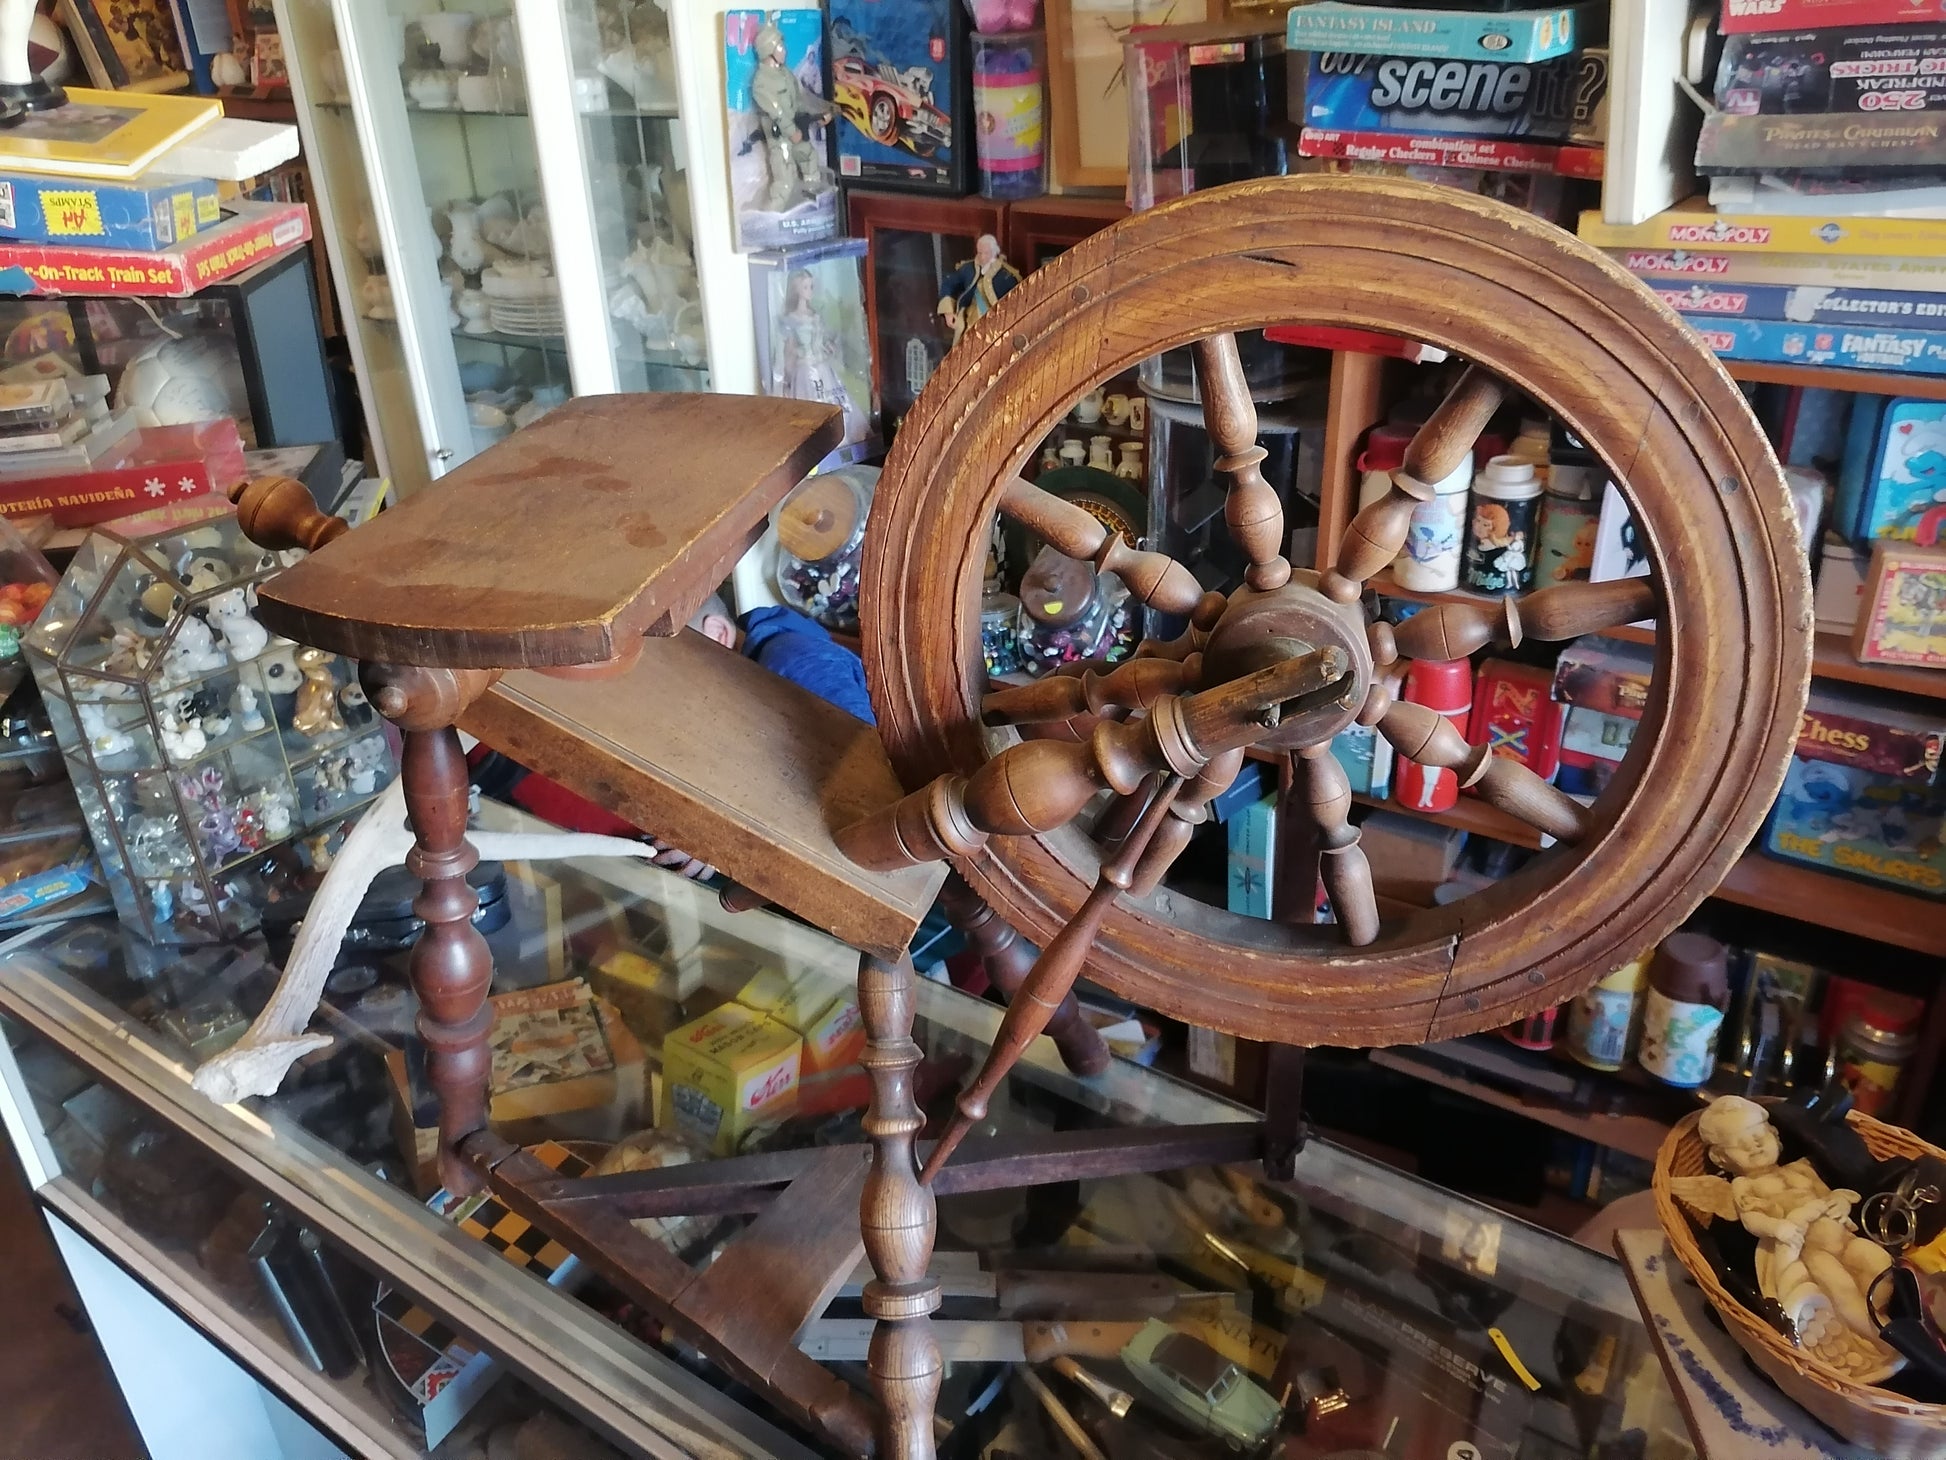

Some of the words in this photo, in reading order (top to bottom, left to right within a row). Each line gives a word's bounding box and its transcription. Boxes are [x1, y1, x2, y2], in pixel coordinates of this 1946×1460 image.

[1729, 0, 1786, 17] WARS
[1296, 15, 1366, 31] FANTASY
[1372, 18, 1437, 33] ISLAND
[1830, 59, 1918, 78] TRICKS
[1371, 58, 1534, 113] scene
[1856, 76, 1946, 90] NDFREAK
[1858, 90, 1926, 111] 250
[1346, 144, 1388, 160] Regular
[1388, 146, 1436, 161] Checkers
[1409, 137, 1477, 153] combination
[1478, 142, 1496, 155] set
[1457, 151, 1500, 166] Chinese
[1670, 226, 1770, 243] MONOPOLY
[1628, 254, 1729, 273] MONOPOLY
[107, 266, 146, 283] Train
[149, 268, 174, 285] Set
[1815, 297, 1914, 315] COLLECTOR'S
[1841, 333, 1928, 358] FANTASY
[0, 495, 54, 515] OTERÍA
[57, 486, 136, 508] NAVIDEÑA
[1799, 713, 1871, 751] Chess
[1401, 1321, 1509, 1395] PRESERVE
